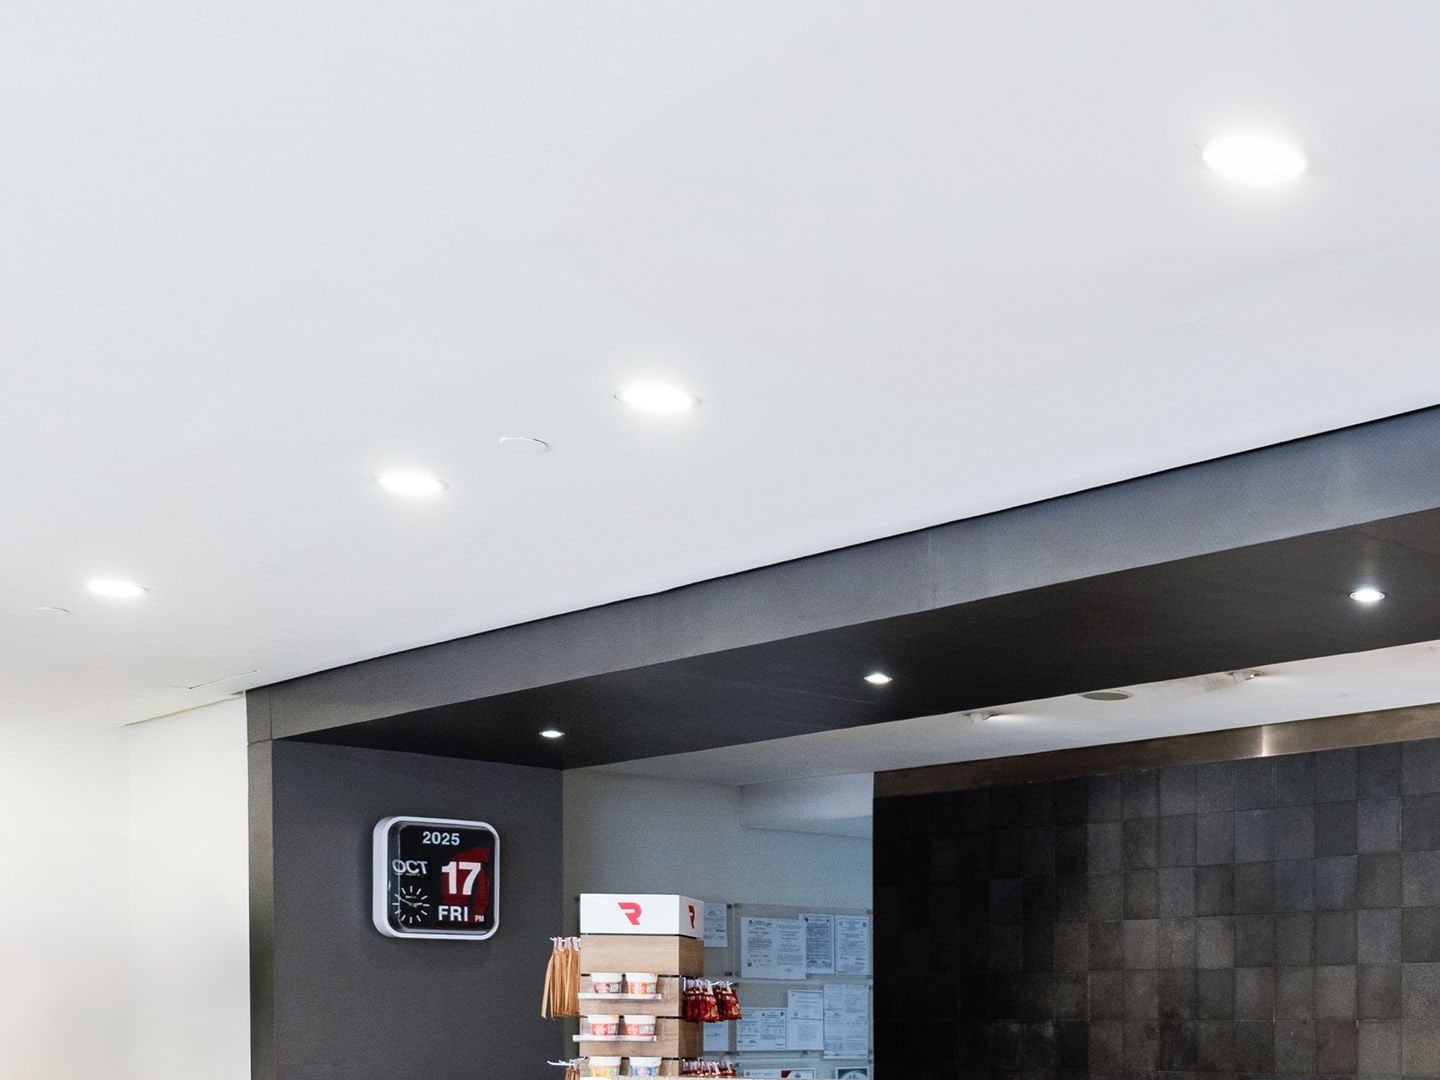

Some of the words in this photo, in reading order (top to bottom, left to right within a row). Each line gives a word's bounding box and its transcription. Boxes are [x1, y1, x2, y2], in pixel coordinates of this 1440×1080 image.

[422, 831, 460, 846] 2025
[392, 859, 428, 875] OCT
[441, 861, 481, 896] 17
[438, 905, 468, 922] FRI
